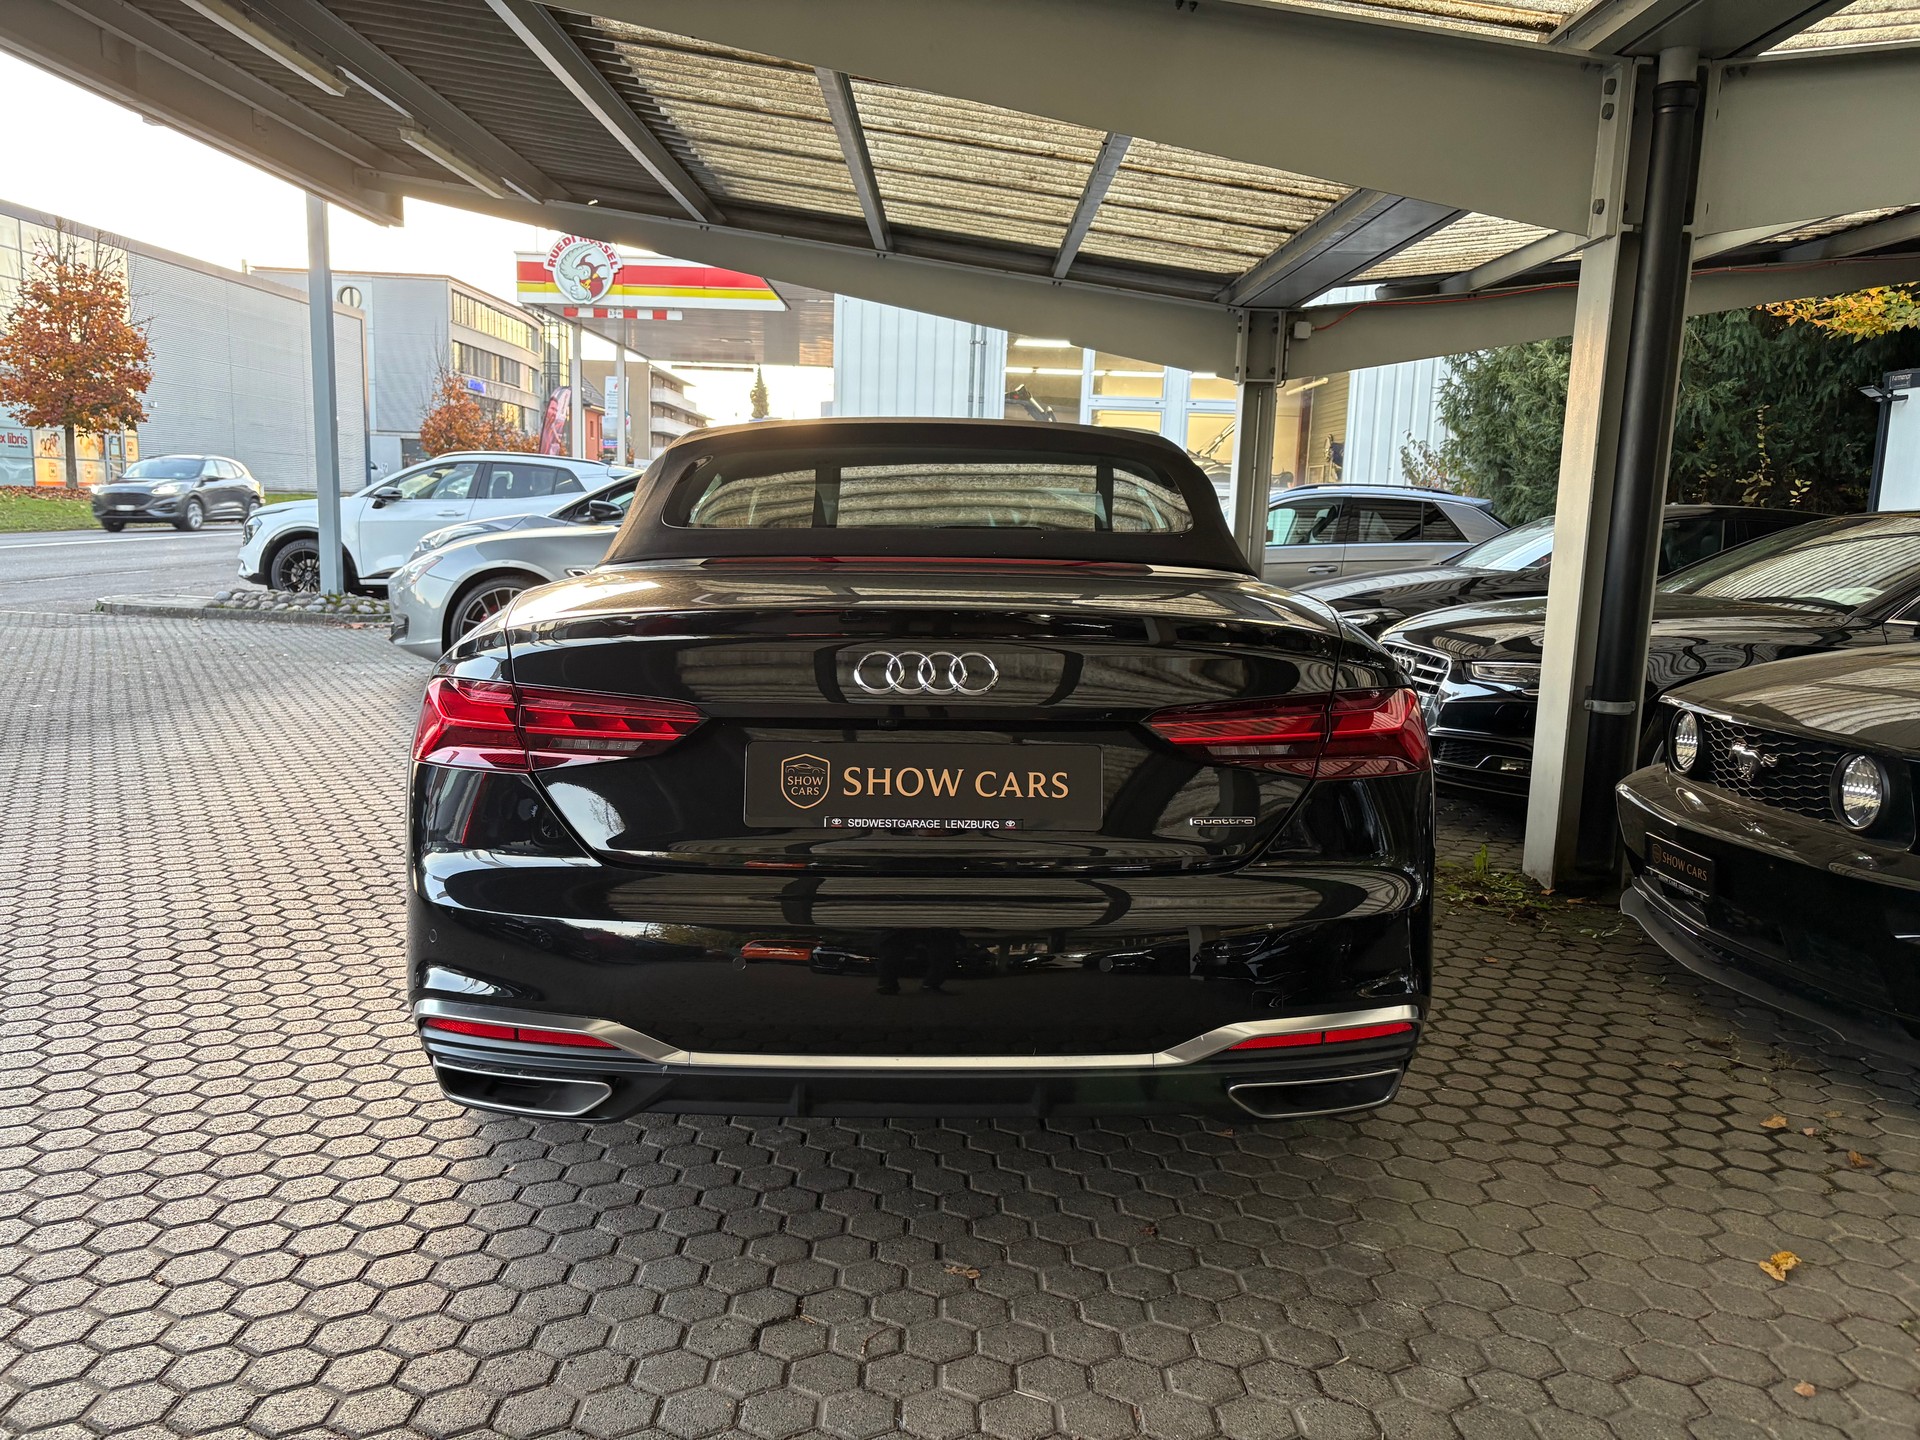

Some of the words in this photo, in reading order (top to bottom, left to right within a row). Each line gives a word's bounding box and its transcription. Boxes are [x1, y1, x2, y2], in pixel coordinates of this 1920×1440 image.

[547, 236, 576, 267] RUEDI
[7, 432, 28, 444] libris
[787, 775, 824, 786] SHOW
[843, 767, 964, 797] SHOW
[975, 770, 1069, 799] CARS
[791, 786, 820, 796] CARS
[945, 819, 1000, 830] LENZBURG
[1193, 818, 1253, 826] quattro
[1663, 852, 1685, 871] SHOW
[1687, 864, 1707, 881] CARS
